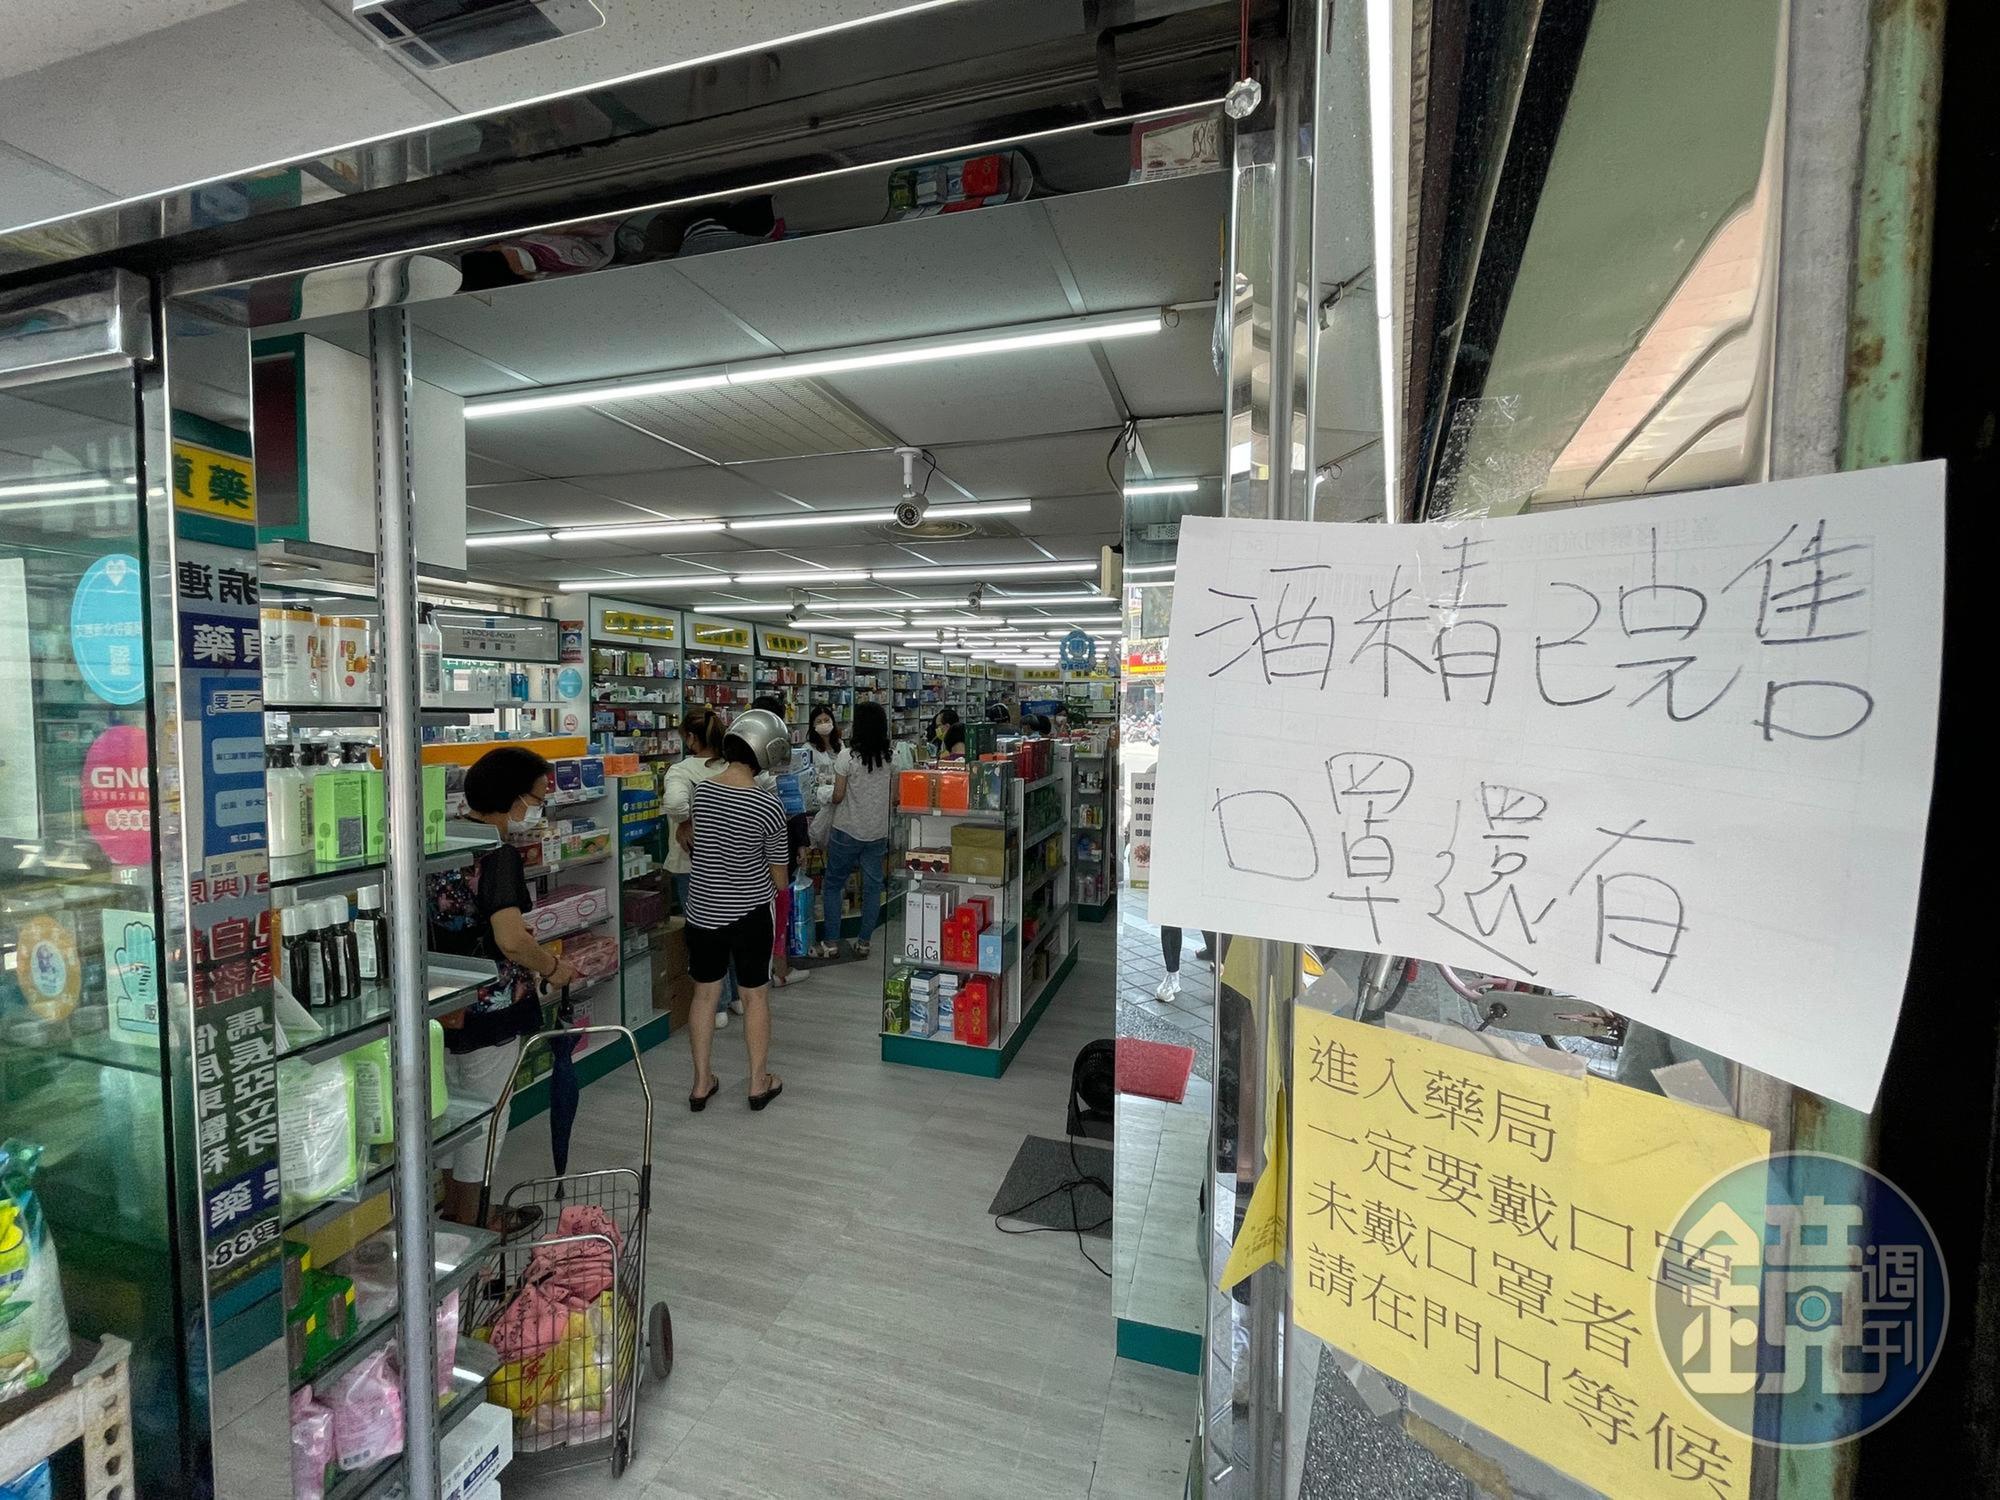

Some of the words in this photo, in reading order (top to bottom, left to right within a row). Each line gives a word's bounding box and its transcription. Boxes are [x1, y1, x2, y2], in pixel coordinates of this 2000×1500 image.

[1194, 517, 1874, 742] 酒精已完售
[906, 943, 920, 959] Ca
[925, 946, 939, 961] Ca
[1212, 751, 1694, 995] 口罩還有
[1307, 1036, 1558, 1164] 進入藥局
[1307, 1122, 1739, 1314] 一定要戴口罩
[1307, 1179, 1644, 1369] 未戴口罩者
[1307, 1244, 1733, 1500] 請在門口等候
